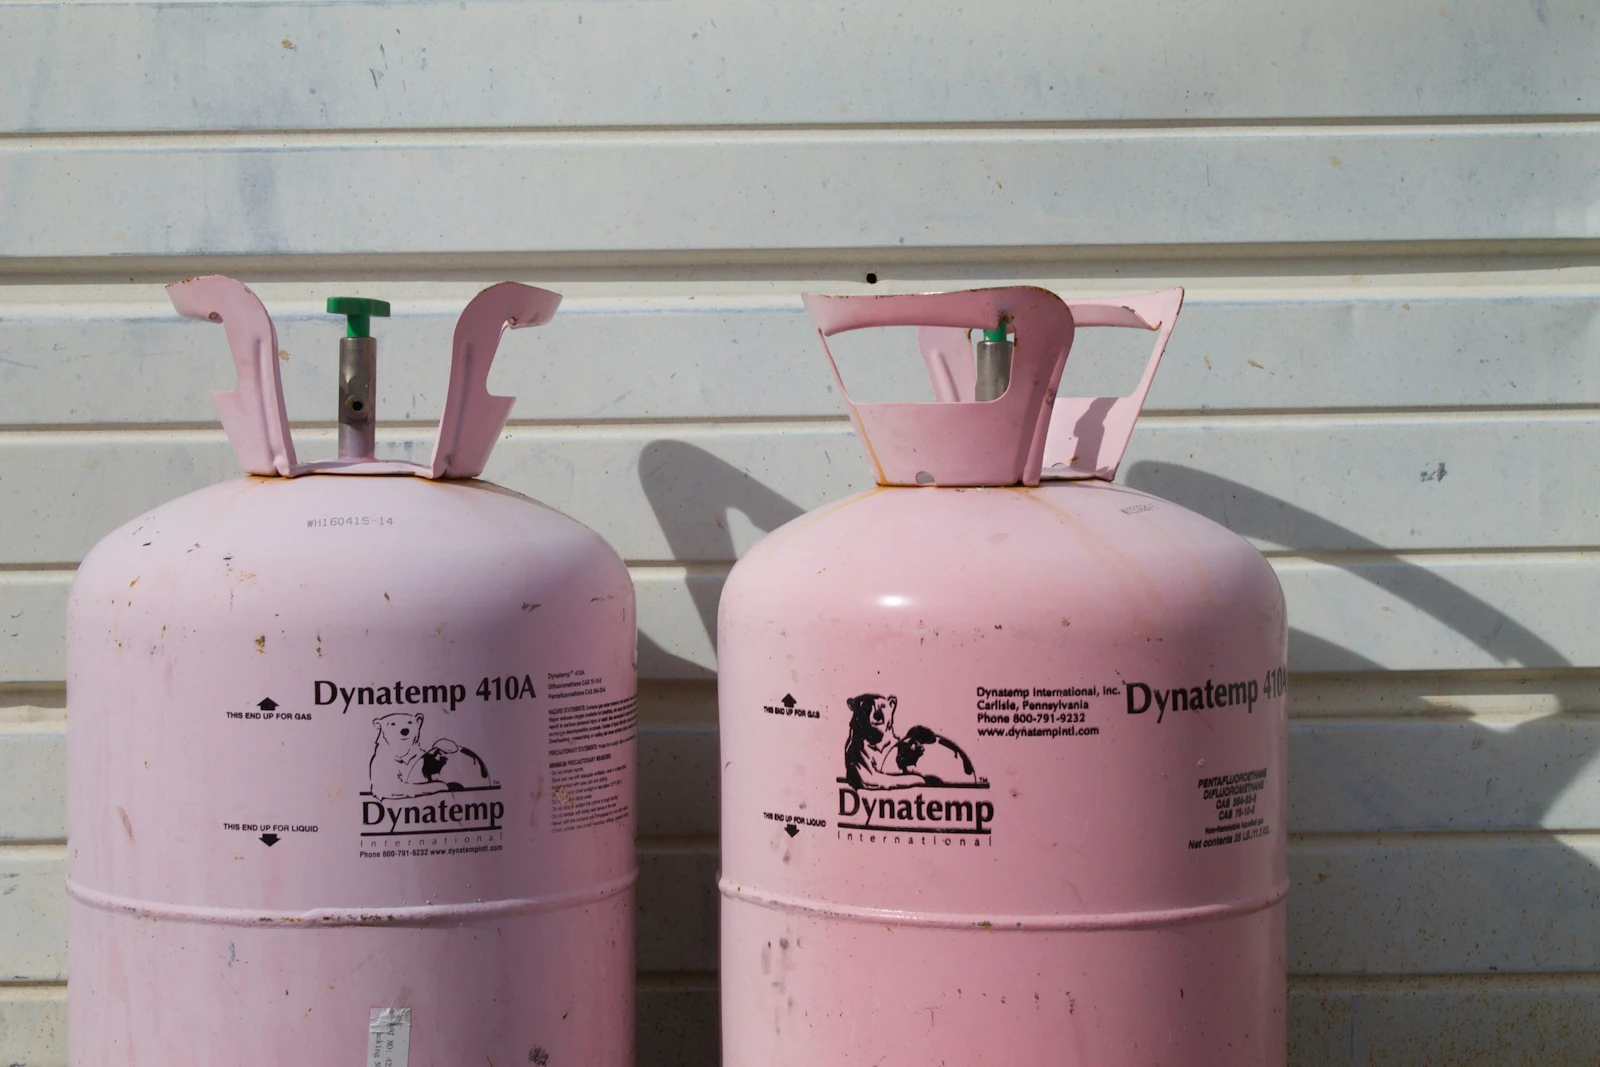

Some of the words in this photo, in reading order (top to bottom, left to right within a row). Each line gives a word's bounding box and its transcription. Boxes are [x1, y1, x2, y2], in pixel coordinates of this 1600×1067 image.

[307, 517, 394, 528] WH160415-14
[315, 681, 465, 714] Dynatemp
[476, 675, 536, 701] 410A
[977, 688, 1030, 698] Dynatemp
[1033, 686, 1100, 697] International,
[1102, 686, 1121, 696] Inc.
[977, 700, 1019, 711] Carlisle,
[1022, 700, 1089, 711] Pennsylvania
[1125, 680, 1259, 722] Dynatemp
[245, 712, 260, 720] END
[977, 713, 1009, 723] Phone
[1013, 713, 1086, 723] 800-791-9232
[977, 726, 1100, 739] www.dynatempintl.com
[1198, 768, 1267, 789] PENTAFLUOROETHANE
[837, 787, 995, 830] Dynatemp
[1216, 797, 1230, 809] CAS
[361, 799, 504, 834] Dynatemp
[1219, 809, 1232, 820] CAS
[292, 825, 318, 833] LIQUID
[1188, 839, 1201, 849] Net
[1203, 835, 1232, 847] contents
[360, 850, 381, 858] Phone
[383, 848, 429, 857] 800-791-9232
[430, 844, 503, 856] www.dynatempintl.com
